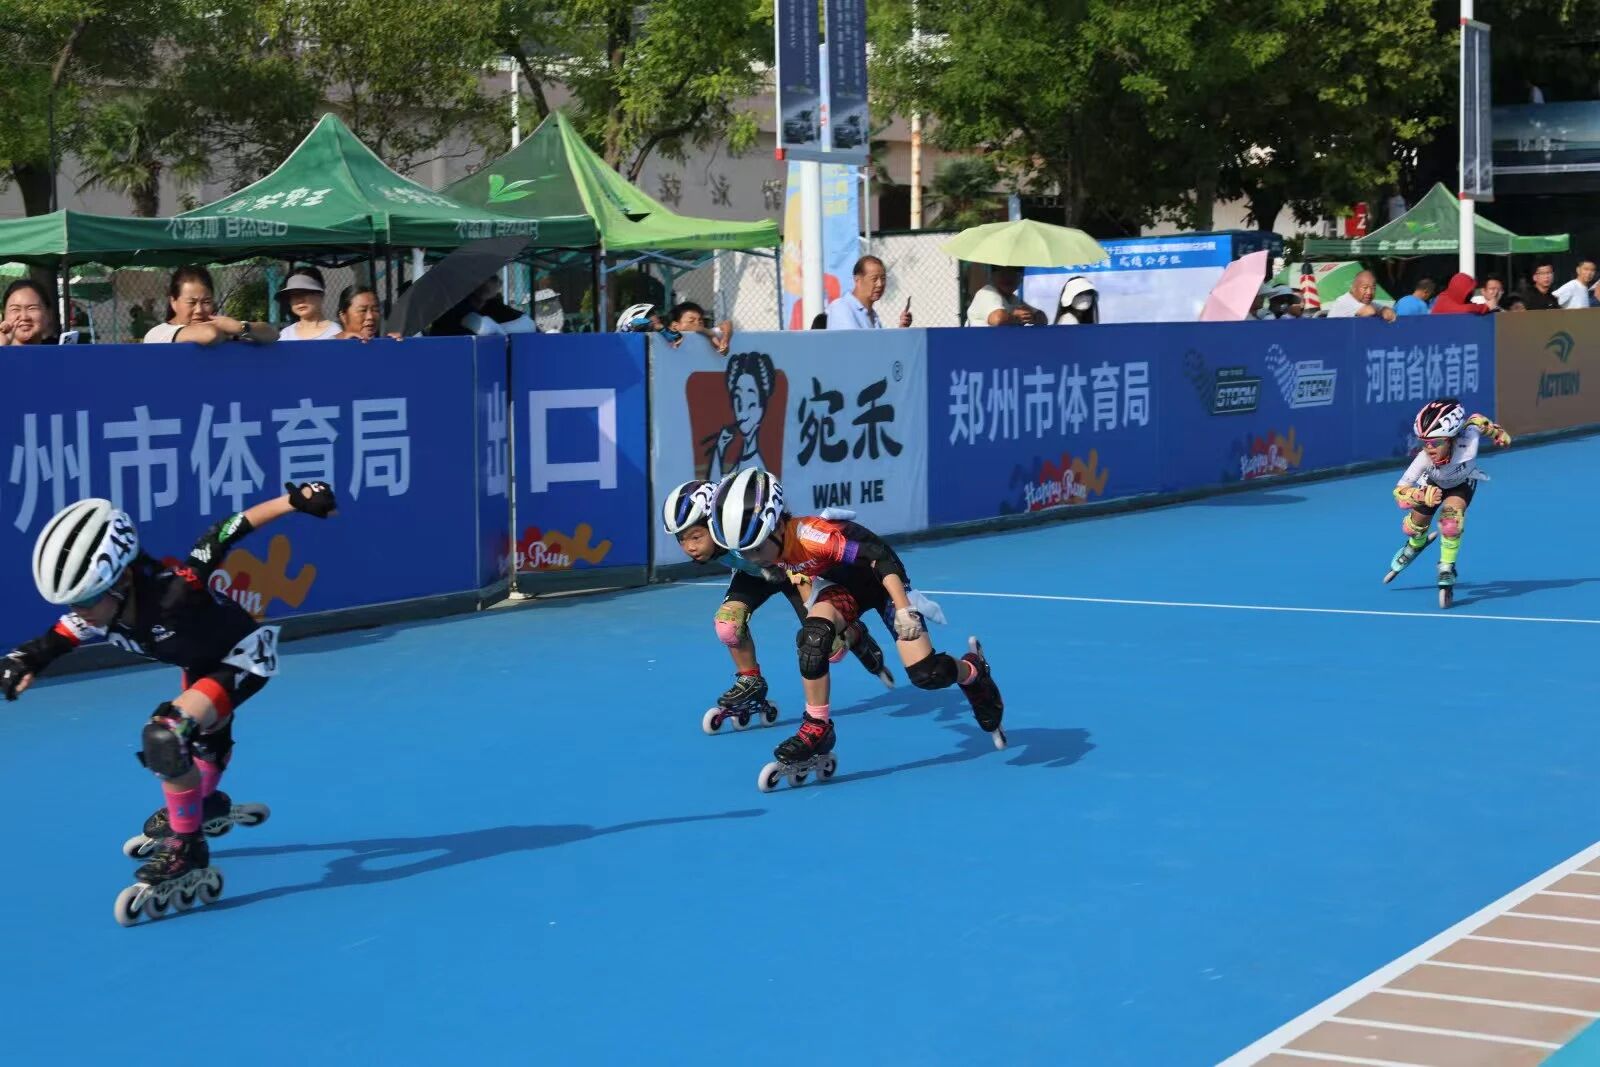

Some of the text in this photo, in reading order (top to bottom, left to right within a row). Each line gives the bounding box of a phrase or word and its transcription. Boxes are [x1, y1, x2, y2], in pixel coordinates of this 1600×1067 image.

[1366, 343, 1480, 403] 河南省体育局
[797, 376, 904, 466] 宛禾
[949, 361, 1150, 445] 郑州市体育局
[812, 479, 885, 509] WAN HE
[1023, 469, 1087, 511] Happy Run
[528, 541, 570, 569] Run
